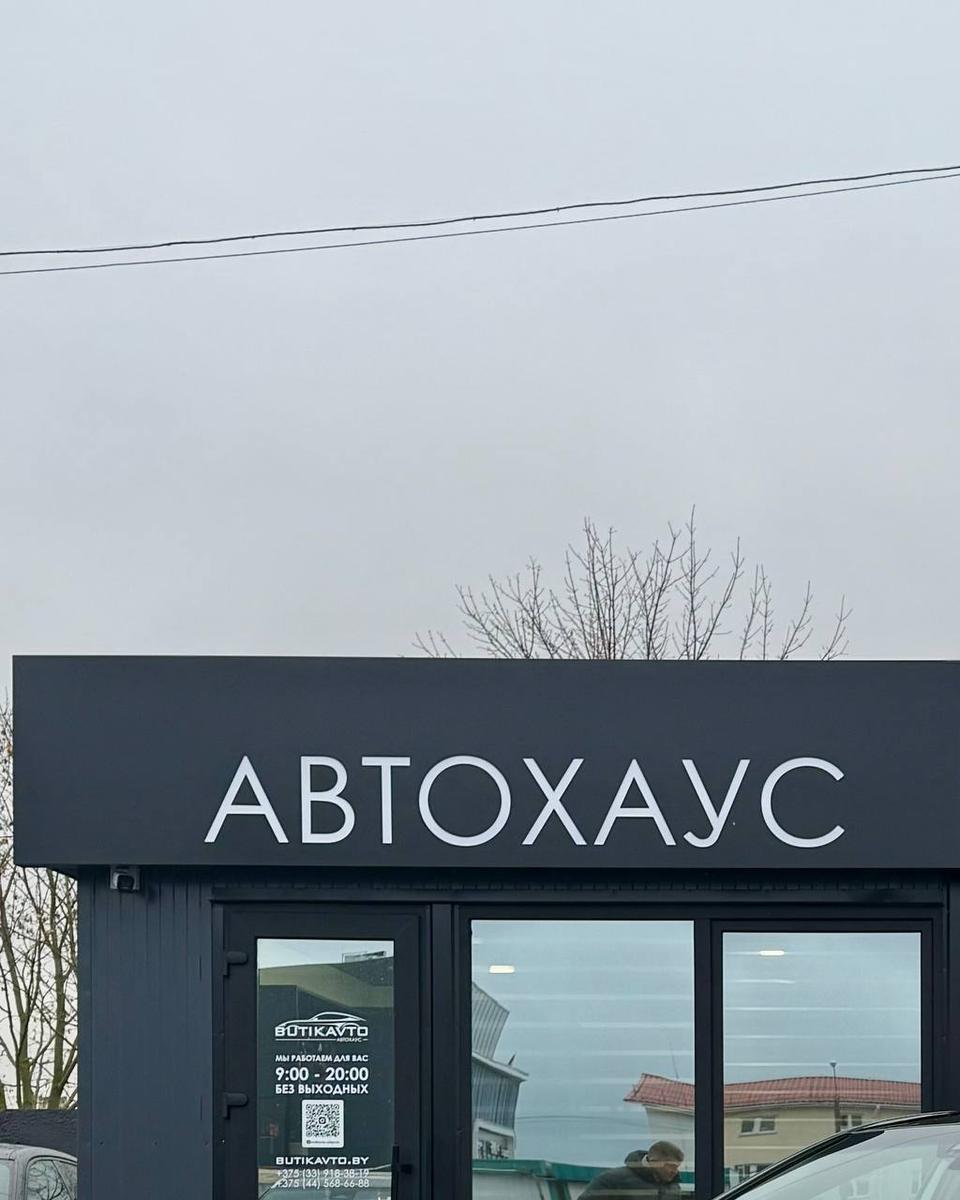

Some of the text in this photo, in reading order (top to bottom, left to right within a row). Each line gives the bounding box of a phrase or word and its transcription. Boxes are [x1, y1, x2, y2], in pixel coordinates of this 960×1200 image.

[204, 755, 845, 848] АВТОХАУС
[275, 1026, 369, 1037] BUTIKAVTO
[275, 1054, 369, 1062] МЫ РАБОТАЕМ ДЛЯ ВАС
[275, 1067, 309, 1081] 9:00
[325, 1067, 369, 1081] 20:00
[275, 1084, 369, 1095] БЕЗ ВЫХОДНЫХ
[275, 1157, 369, 1165] BUTIKAVTO.BY
[302, 1169, 320, 1179] (33)
[302, 1179, 320, 1189] (44)
